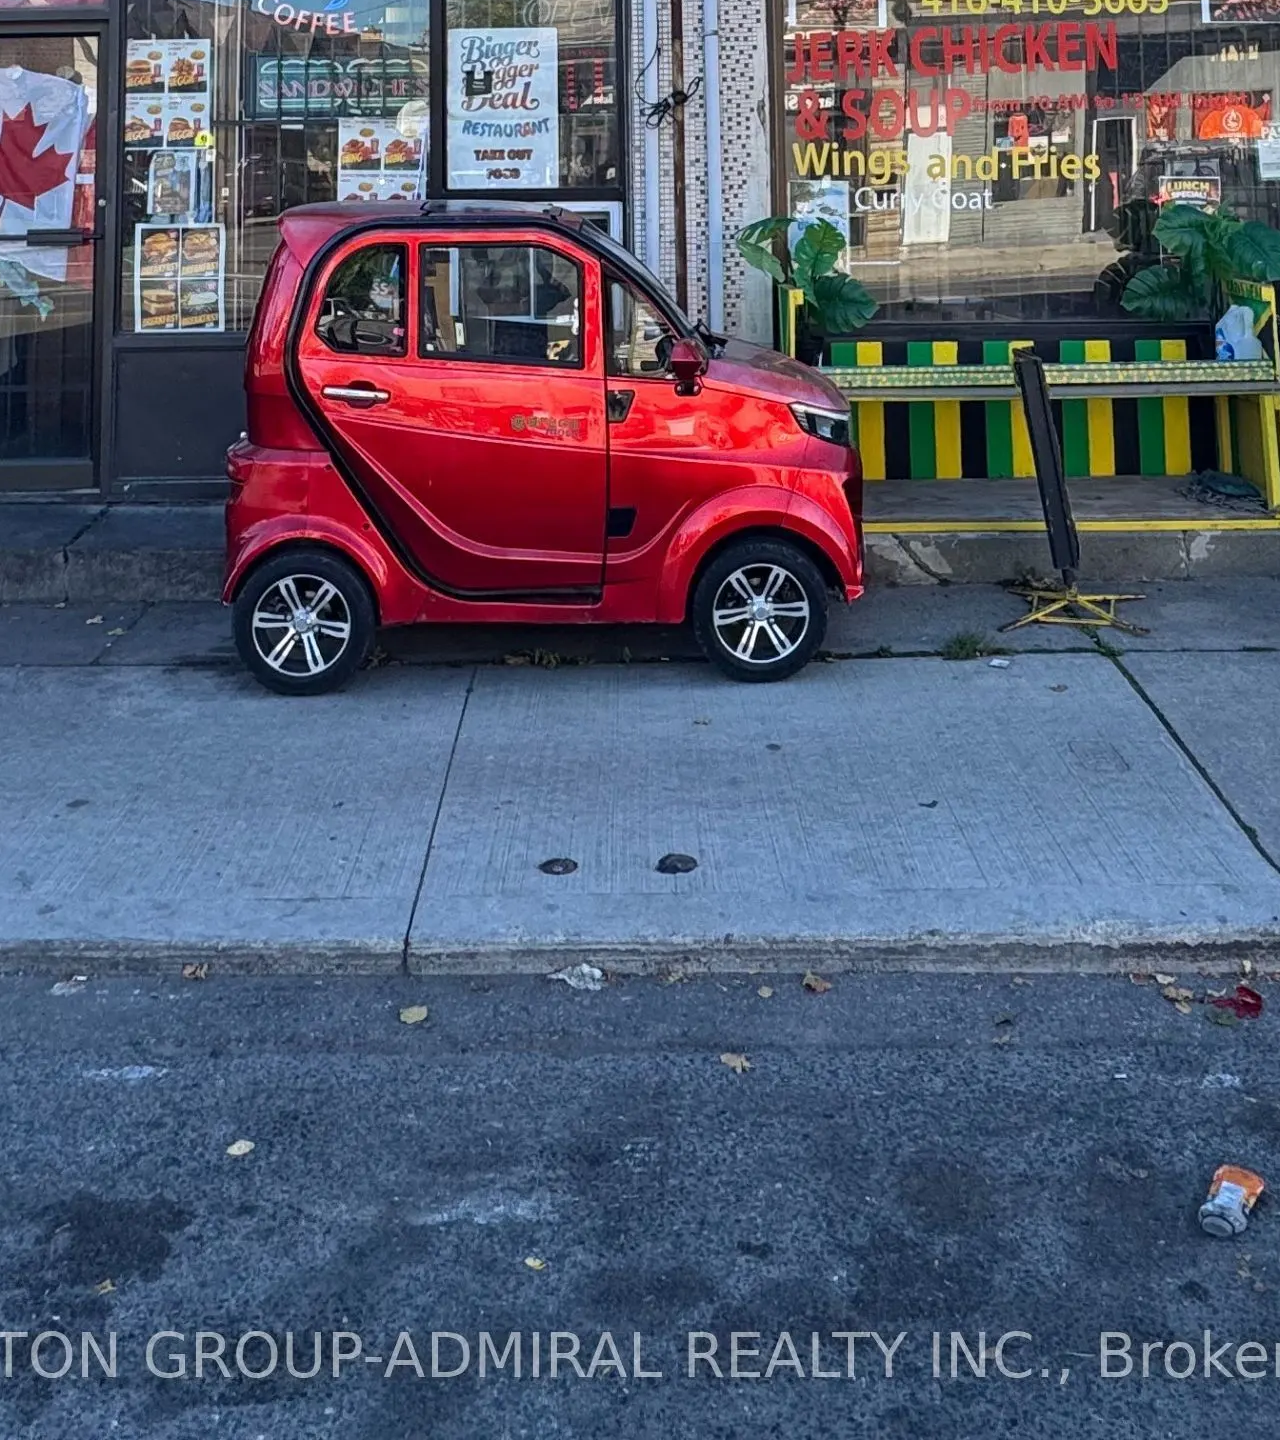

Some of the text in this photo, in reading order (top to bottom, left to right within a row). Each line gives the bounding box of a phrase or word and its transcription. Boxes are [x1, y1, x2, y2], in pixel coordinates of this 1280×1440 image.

[461, 36, 540, 67] Bigger
[786, 22, 1118, 82] JERK CHICKEN
[462, 118, 550, 138] RESTAURANT
[794, 88, 972, 141] & SOUP
[507, 148, 533, 161] OUT
[792, 142, 1101, 185] Wings and Fries
[1167, 180, 1210, 192] LUNCH
